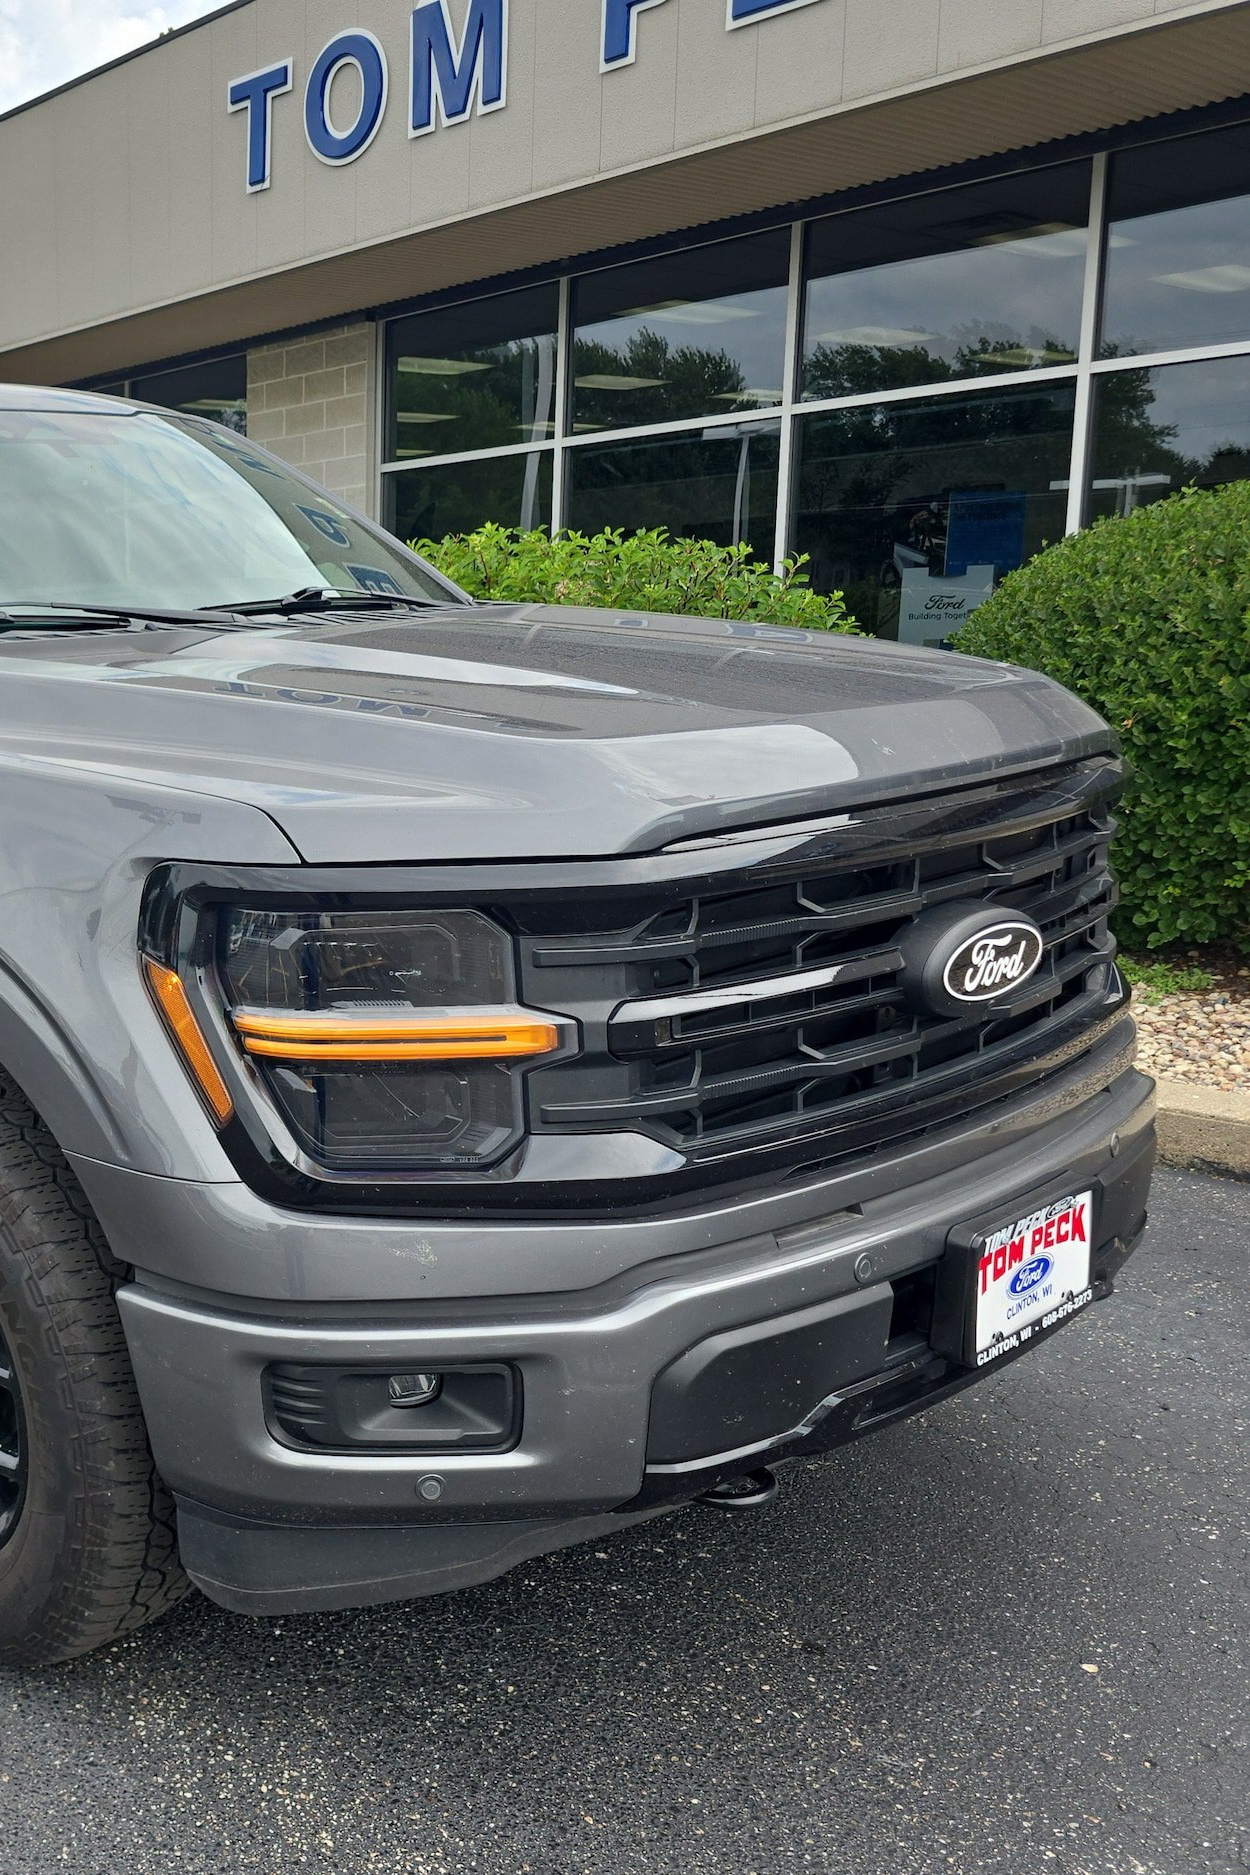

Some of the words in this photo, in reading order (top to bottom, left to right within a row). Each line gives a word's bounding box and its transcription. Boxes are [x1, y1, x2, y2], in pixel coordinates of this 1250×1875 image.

[228, 0, 507, 193] TOM
[908, 612, 942, 621] Building
[943, 612, 967, 620] Toget
[924, 594, 966, 610] Ford
[964, 934, 1027, 993] Ford
[979, 1235, 1025, 1296] TOM
[1030, 1203, 1086, 1256] PECK
[1016, 1262, 1043, 1291] Ford
[1006, 1290, 1040, 1320] CLINTON,
[1042, 1284, 1053, 1298] WI
[976, 1332, 1020, 1367] CLINTON,
[1020, 1325, 1032, 1342] WI
[1042, 1289, 1093, 1329] 608-676-2273
